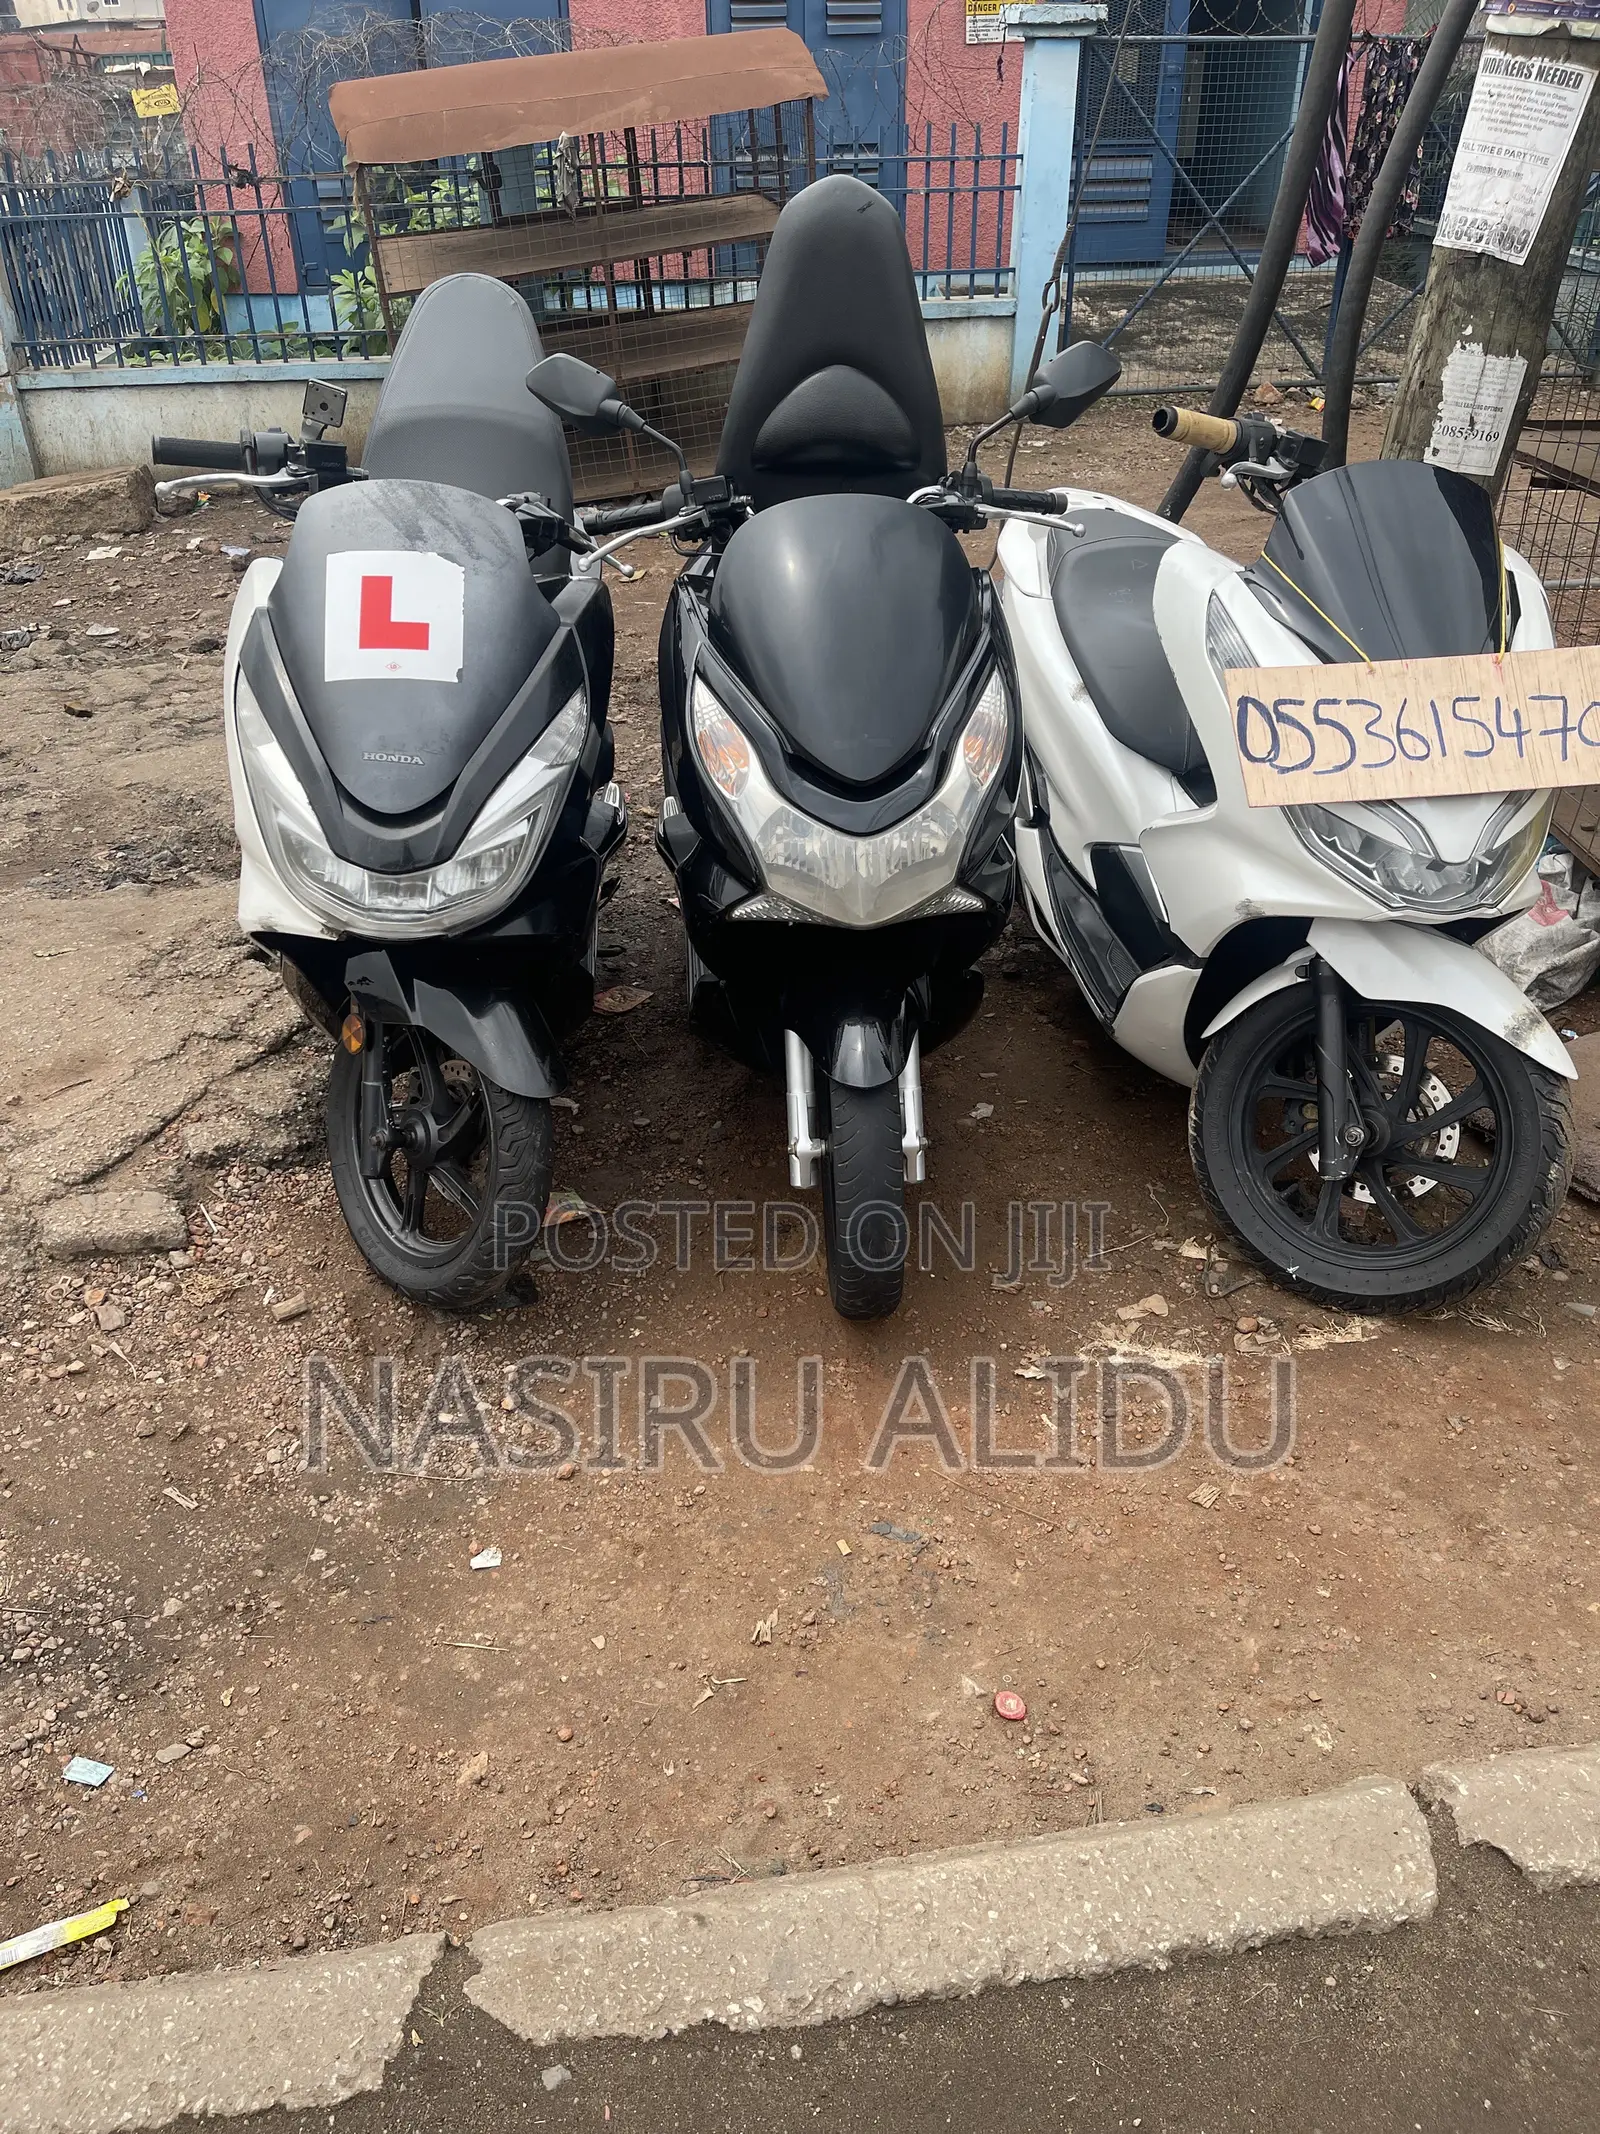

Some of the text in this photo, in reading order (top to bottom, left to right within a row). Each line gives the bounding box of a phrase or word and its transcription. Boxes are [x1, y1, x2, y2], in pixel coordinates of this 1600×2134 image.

[968, 3, 997, 12] DANGER
[1481, 57, 1535, 80] WORKERS
[1534, 65, 1584, 90] NEEDED
[1476, 143, 1495, 154] TIME
[1503, 149, 1526, 160] PART
[1528, 154, 1549, 165] TIME
[358, 575, 430, 650] L
[362, 752, 425, 765] HONDA
